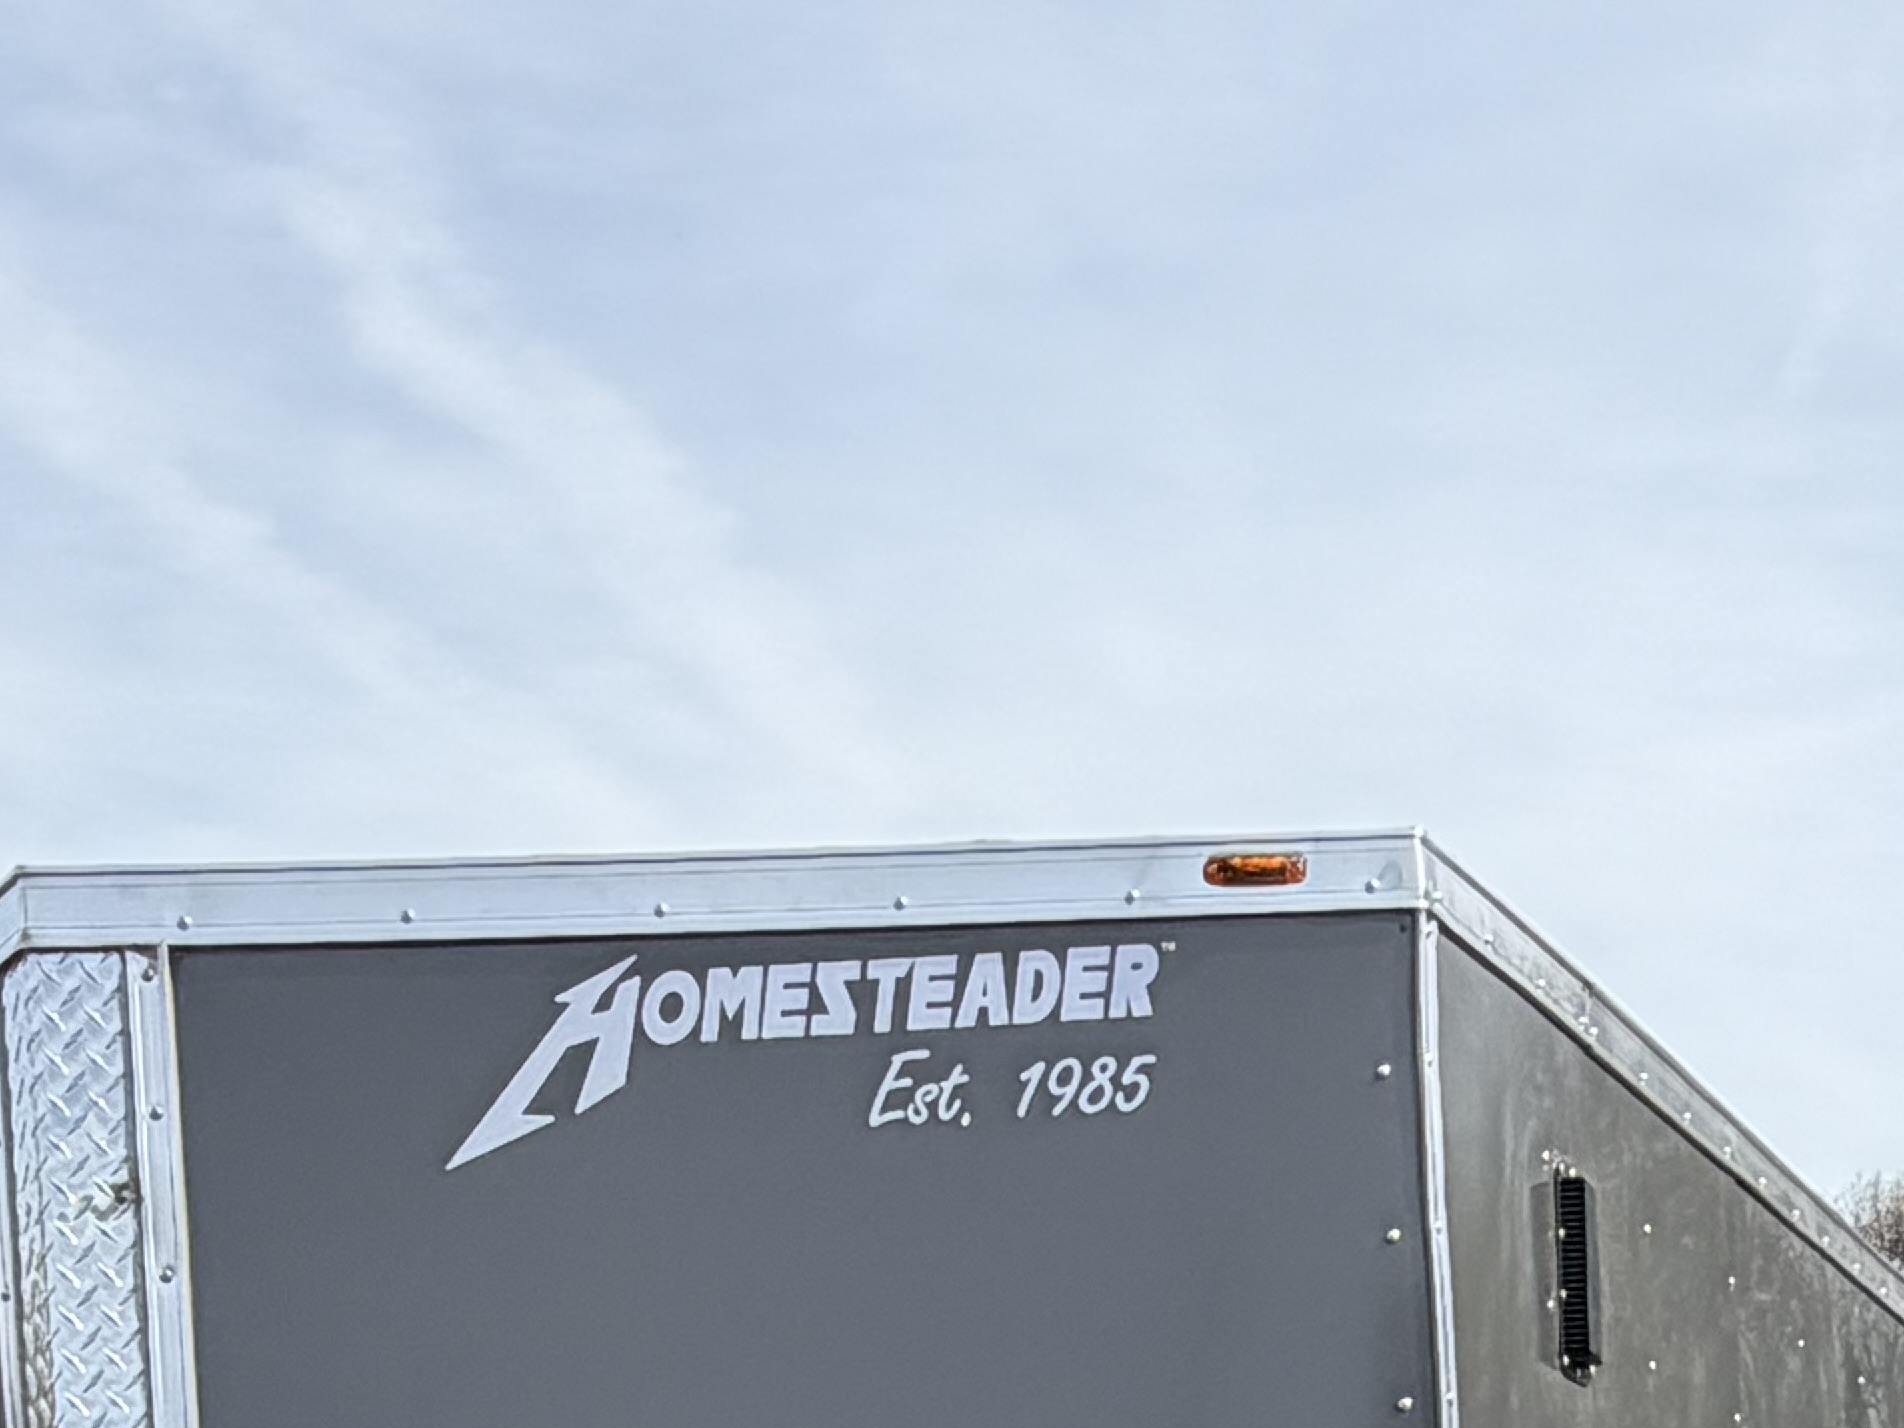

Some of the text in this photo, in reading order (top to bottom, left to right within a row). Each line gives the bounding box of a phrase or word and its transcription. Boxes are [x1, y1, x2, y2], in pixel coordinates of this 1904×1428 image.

[444, 943, 1160, 1171] HOMESTEADER
[868, 1049, 1157, 1128] Est. 1985
